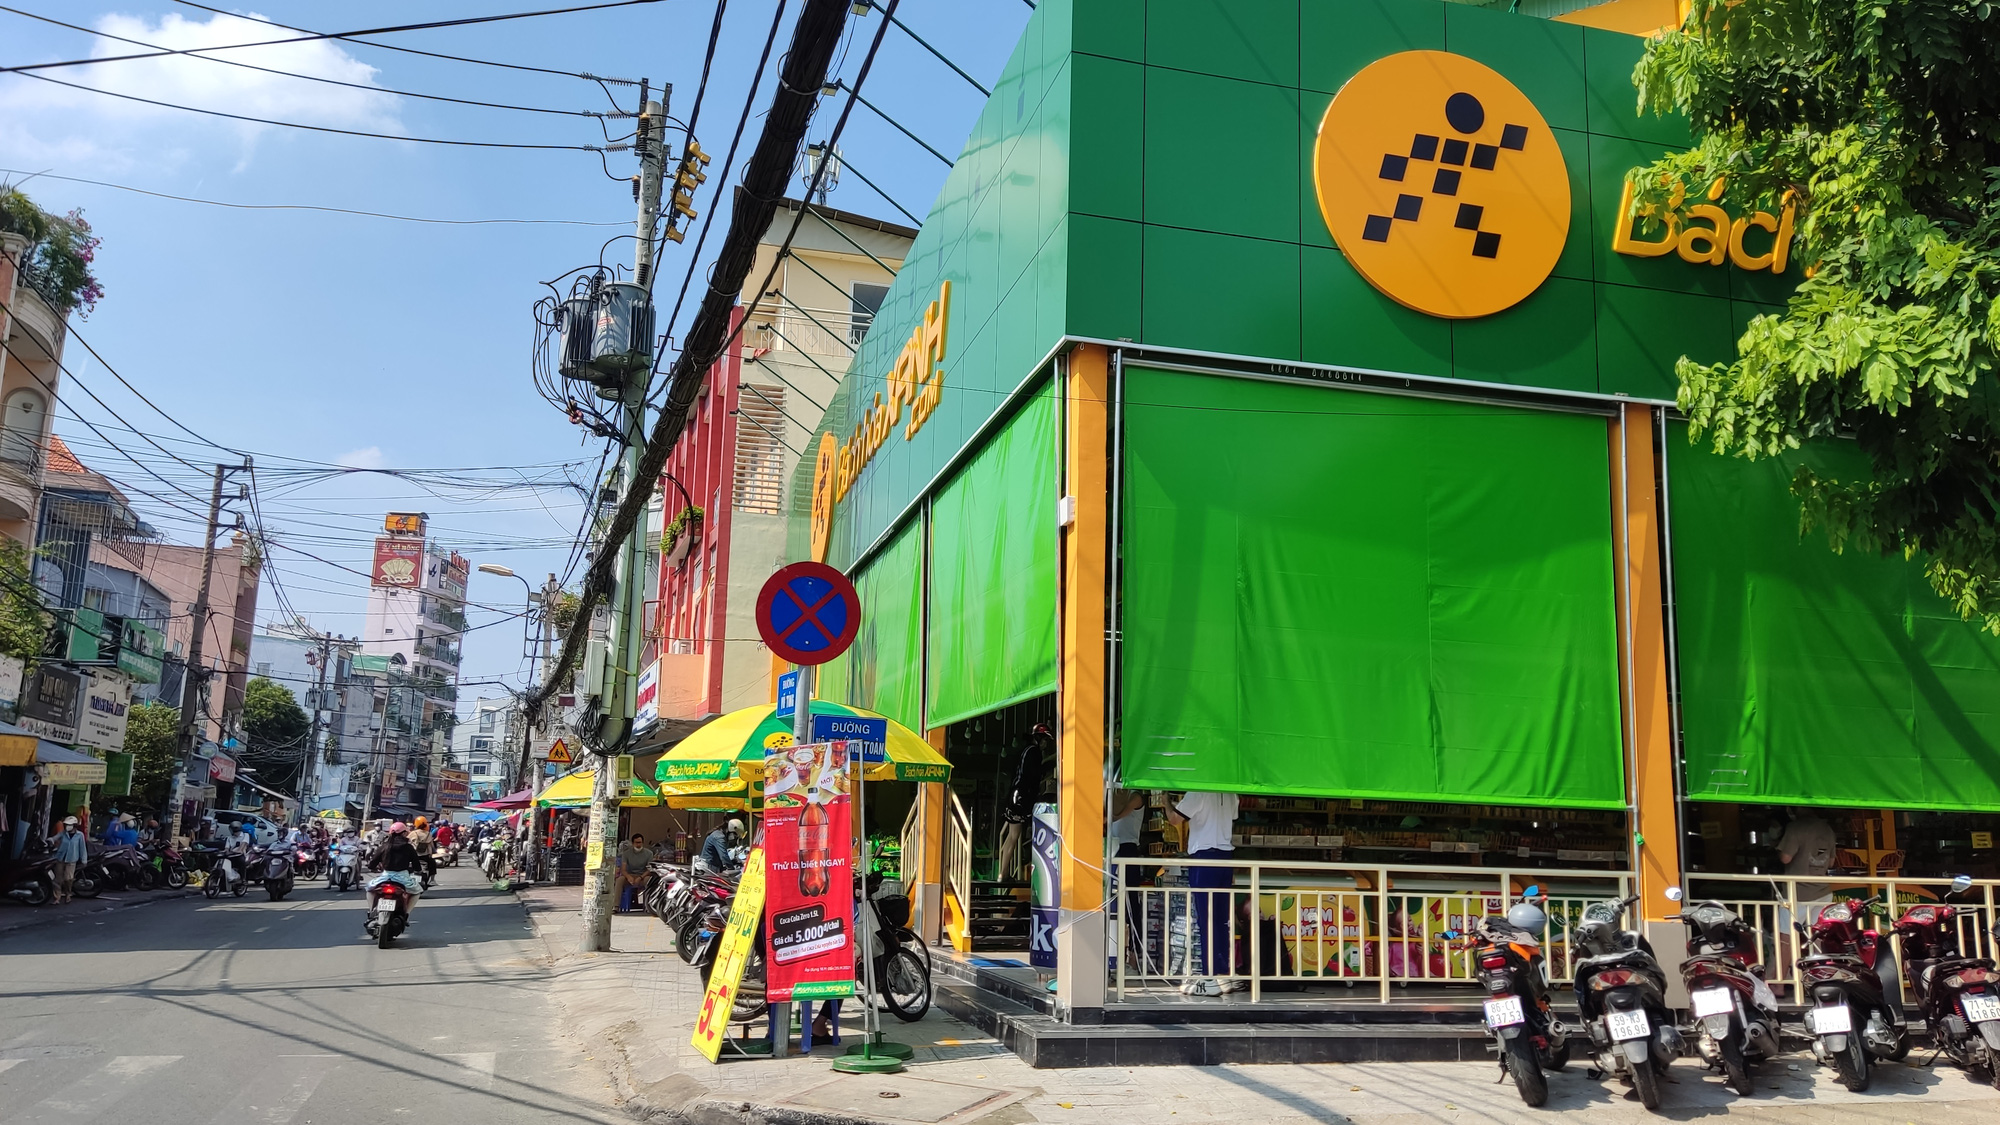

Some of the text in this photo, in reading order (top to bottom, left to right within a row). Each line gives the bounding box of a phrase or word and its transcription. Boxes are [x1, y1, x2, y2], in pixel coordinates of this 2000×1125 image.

[831, 720, 871, 734] ĐƯỜNG
[864, 737, 885, 755] TOẢN
[694, 762, 723, 776] XANH
[925, 765, 945, 777] XANH
[772, 857, 845, 871] Thử là biết NGAY!
[779, 917, 791, 925] Coca
[791, 915, 800, 923] Cola
[800, 912, 811, 921] Zero
[774, 936, 784, 946] Giá
[1968, 997, 1996, 1010] 71-C2
[1490, 1011, 1522, 1025] 837.53
[1614, 1023, 1647, 1038] 196.96
